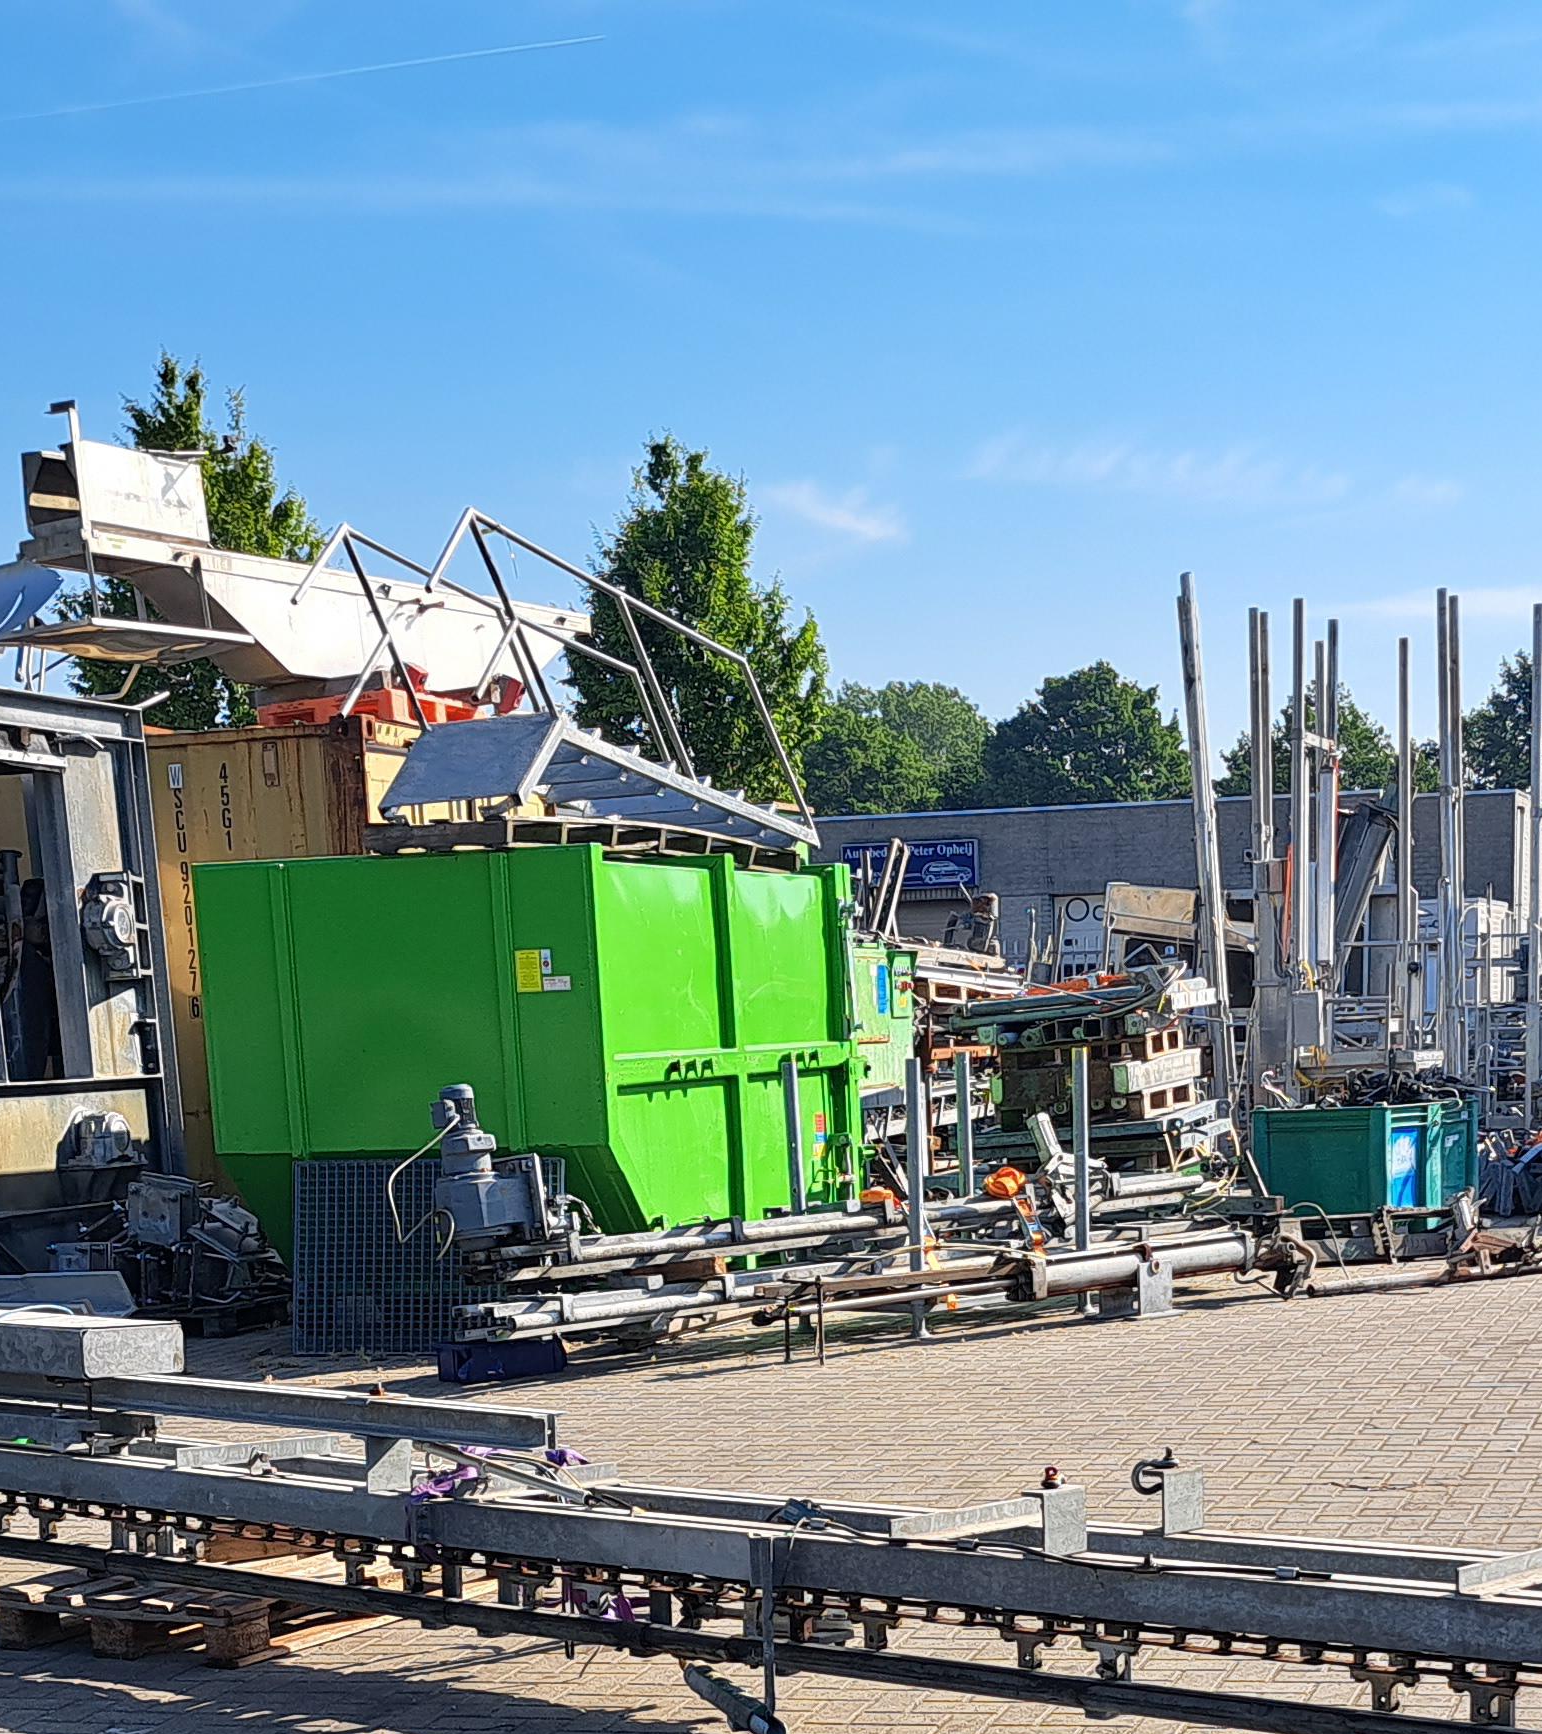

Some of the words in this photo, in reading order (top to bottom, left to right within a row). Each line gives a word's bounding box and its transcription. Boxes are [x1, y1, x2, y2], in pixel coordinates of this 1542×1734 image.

[219, 762, 233, 852] 45G1
[908, 845, 935, 857] Peter
[169, 765, 188, 853] WSCU
[180, 861, 197, 992] 920127
